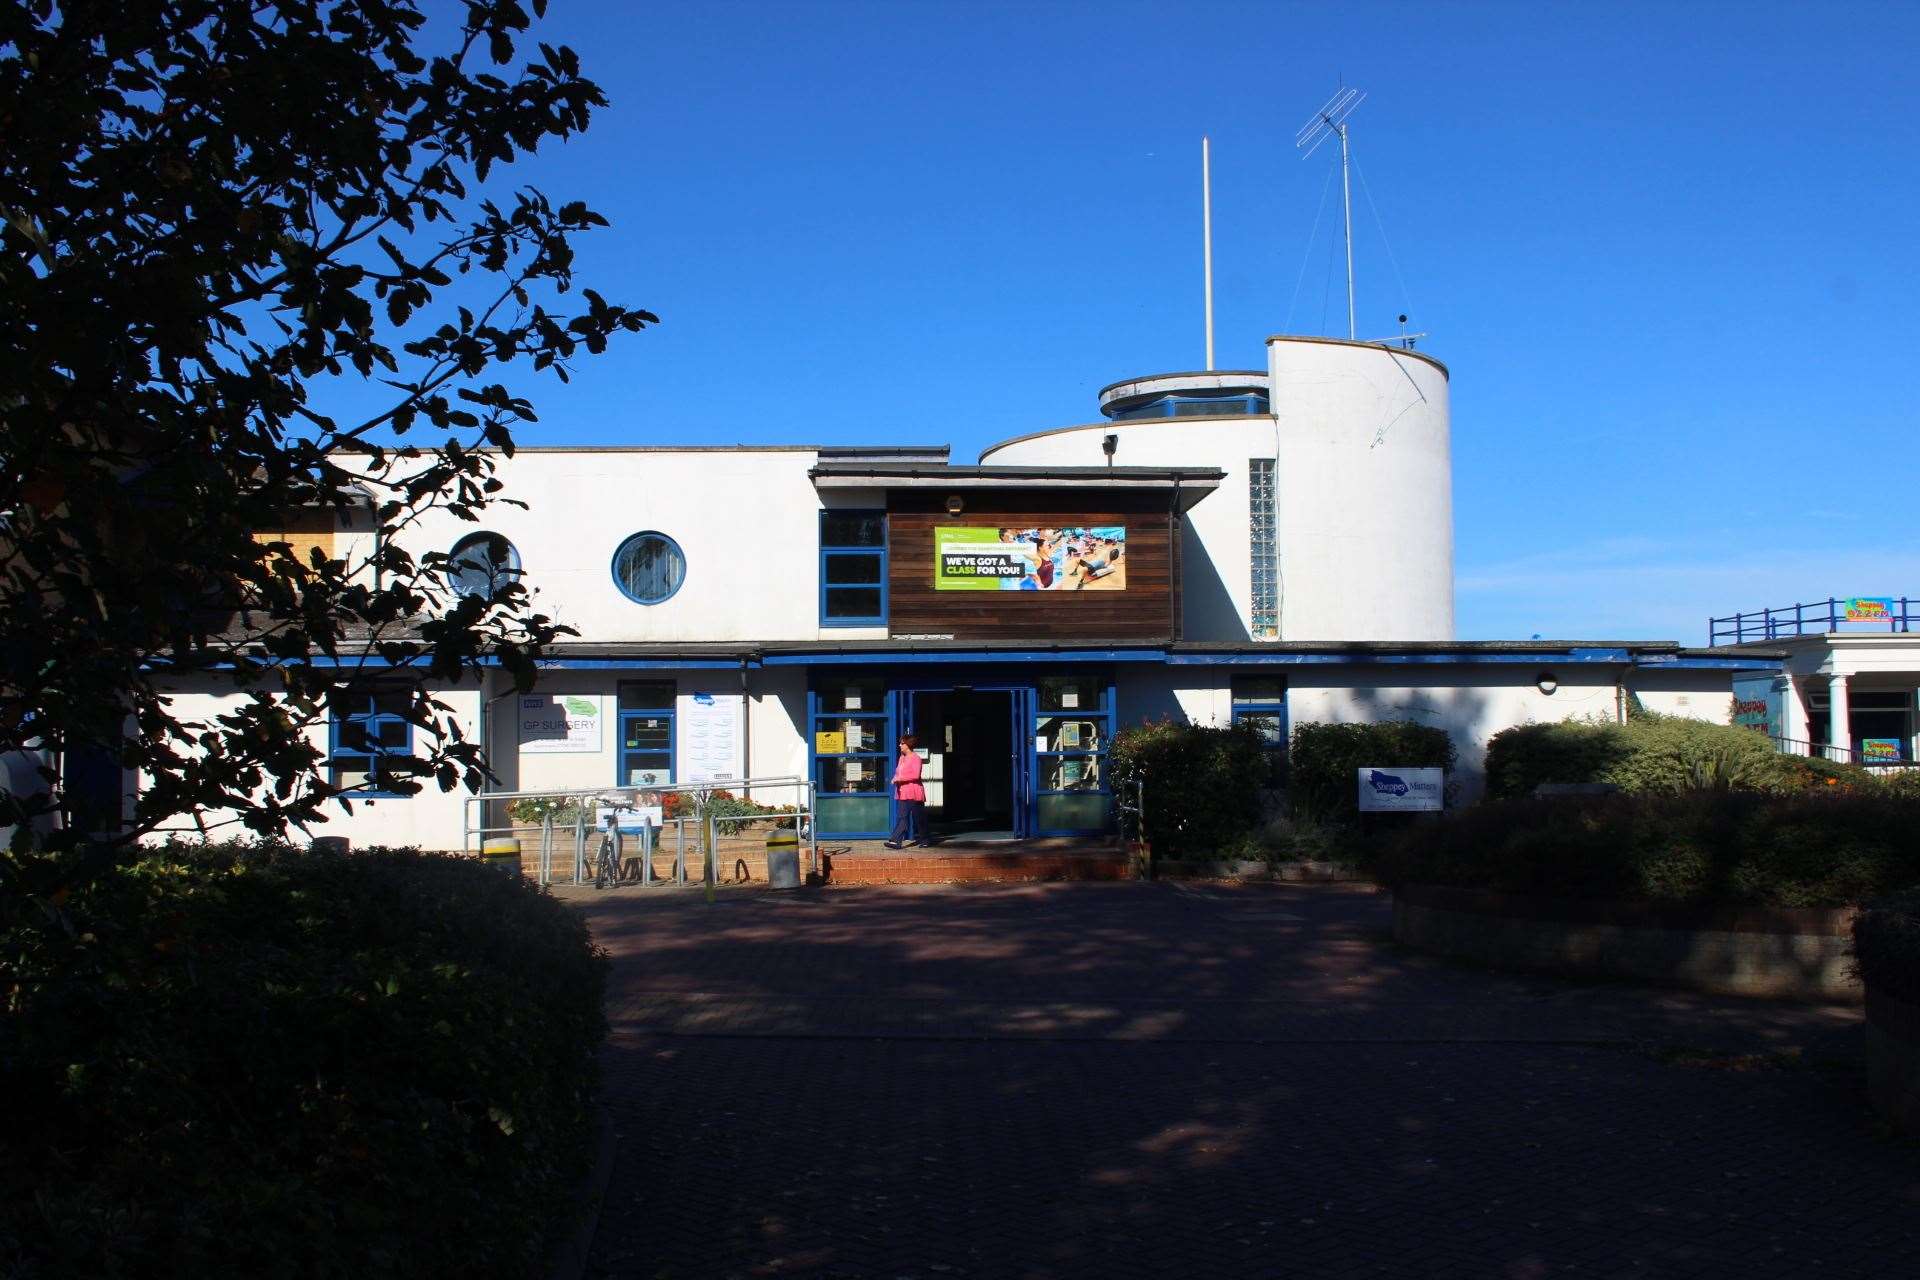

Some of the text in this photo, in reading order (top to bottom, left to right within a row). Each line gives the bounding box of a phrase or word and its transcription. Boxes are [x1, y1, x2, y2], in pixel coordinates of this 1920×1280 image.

[946, 557, 1007, 566] WE'VE GOT A
[946, 566, 1020, 575] CLASS FOR YOU!
[524, 720, 596, 730] GP SURGERY
